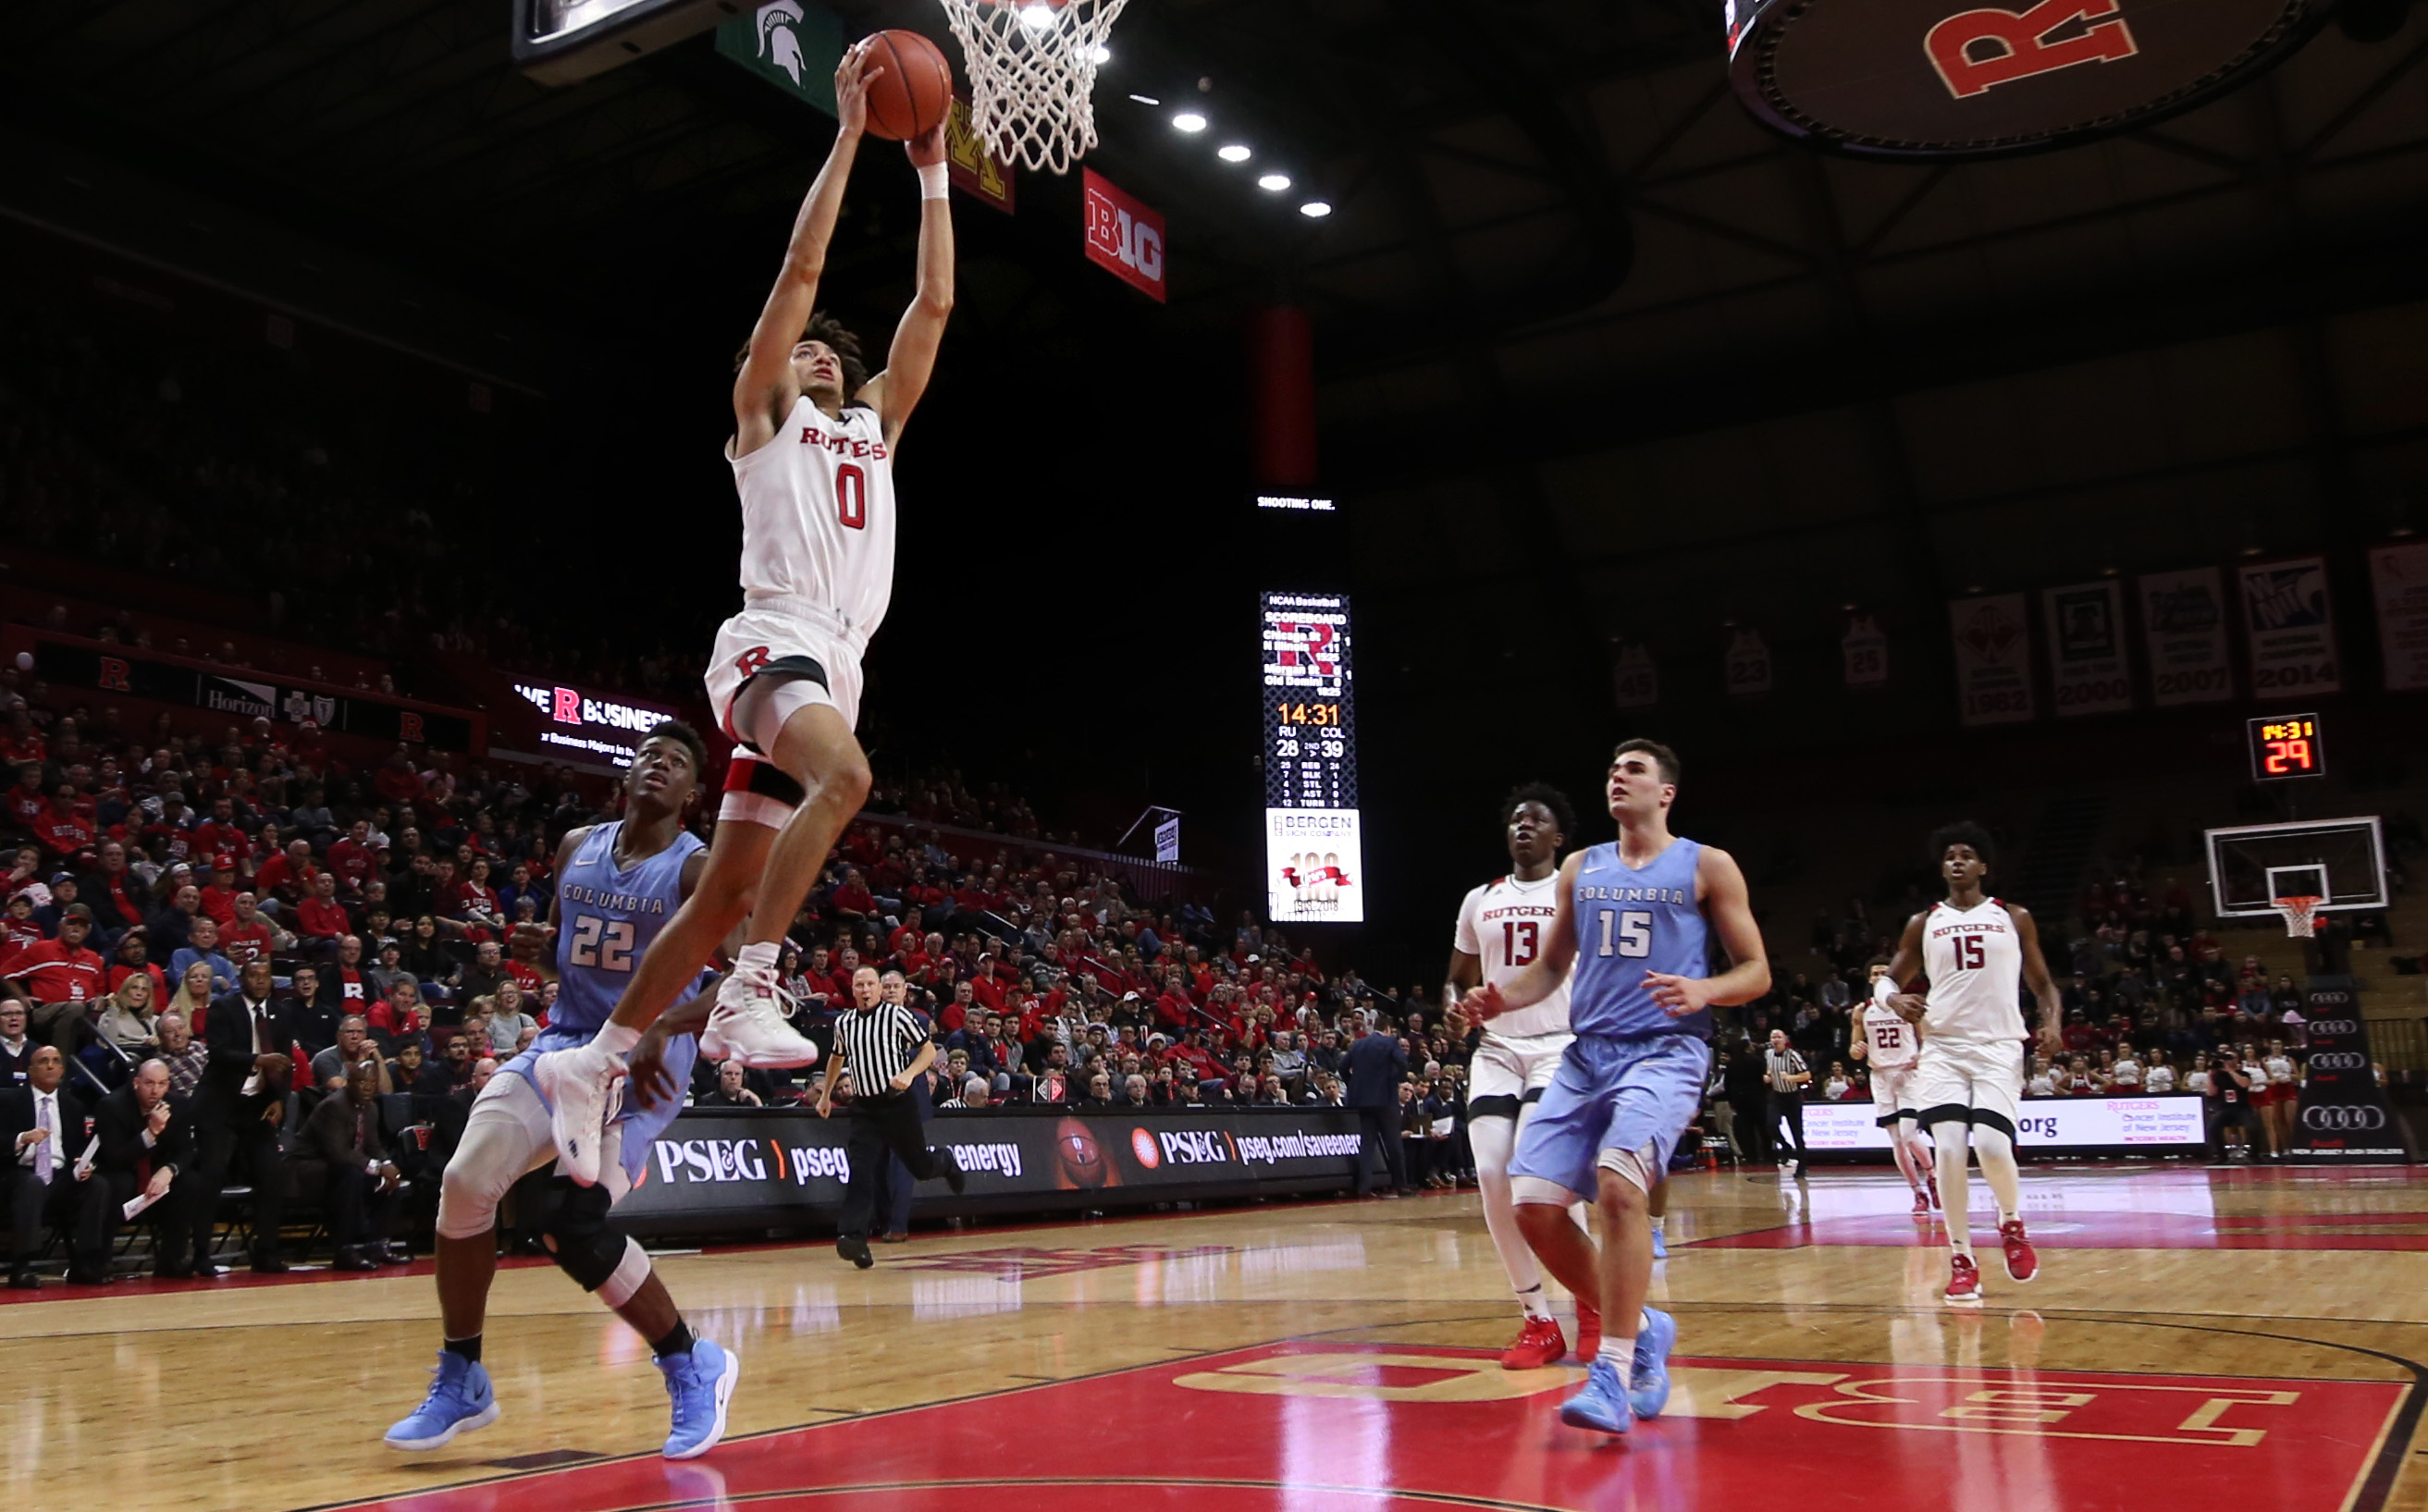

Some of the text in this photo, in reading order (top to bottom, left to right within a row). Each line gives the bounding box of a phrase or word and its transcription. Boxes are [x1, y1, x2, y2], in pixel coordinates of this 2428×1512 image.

[1924, 0, 2138, 99] R
[836, 462, 865, 530] 0
[1258, 497, 1335, 510] SHOOTING ONE.
[1269, 596, 1295, 606] NCAA
[1264, 611, 1347, 625] SCOREBOARD
[1263, 630, 1307, 643] Chicago
[98, 656, 130, 692] R
[1264, 675, 1284, 686] Old
[2157, 666, 2228, 695] 2007
[2255, 662, 2336, 689] 2014
[2058, 679, 2129, 706] 2000
[207, 689, 276, 719] Horizon
[1277, 703, 1340, 726] 14:31
[399, 710, 425, 743] R
[1278, 726, 1346, 739] RU COL
[2262, 721, 2313, 741] 14:31
[1276, 740, 1300, 758] 28
[1321, 741, 1344, 759] 39
[2265, 740, 2311, 773] 29
[1303, 781, 1322, 789] STL
[1303, 790, 1322, 798] AST
[1286, 816, 1351, 829] BERGEN
[563, 883, 664, 915] COLUMBIA
[1577, 886, 1683, 905] COLUMBIA
[1598, 909, 1653, 959] 15
[1932, 923, 2005, 939] RUTGERS
[570, 915, 635, 973] 22
[1503, 921, 1539, 966] 13
[1953, 935, 1985, 971] 15
[343, 982, 364, 999] R
[1876, 1027, 1901, 1049] 22
[2107, 1101, 2161, 1113] RUTGERS
